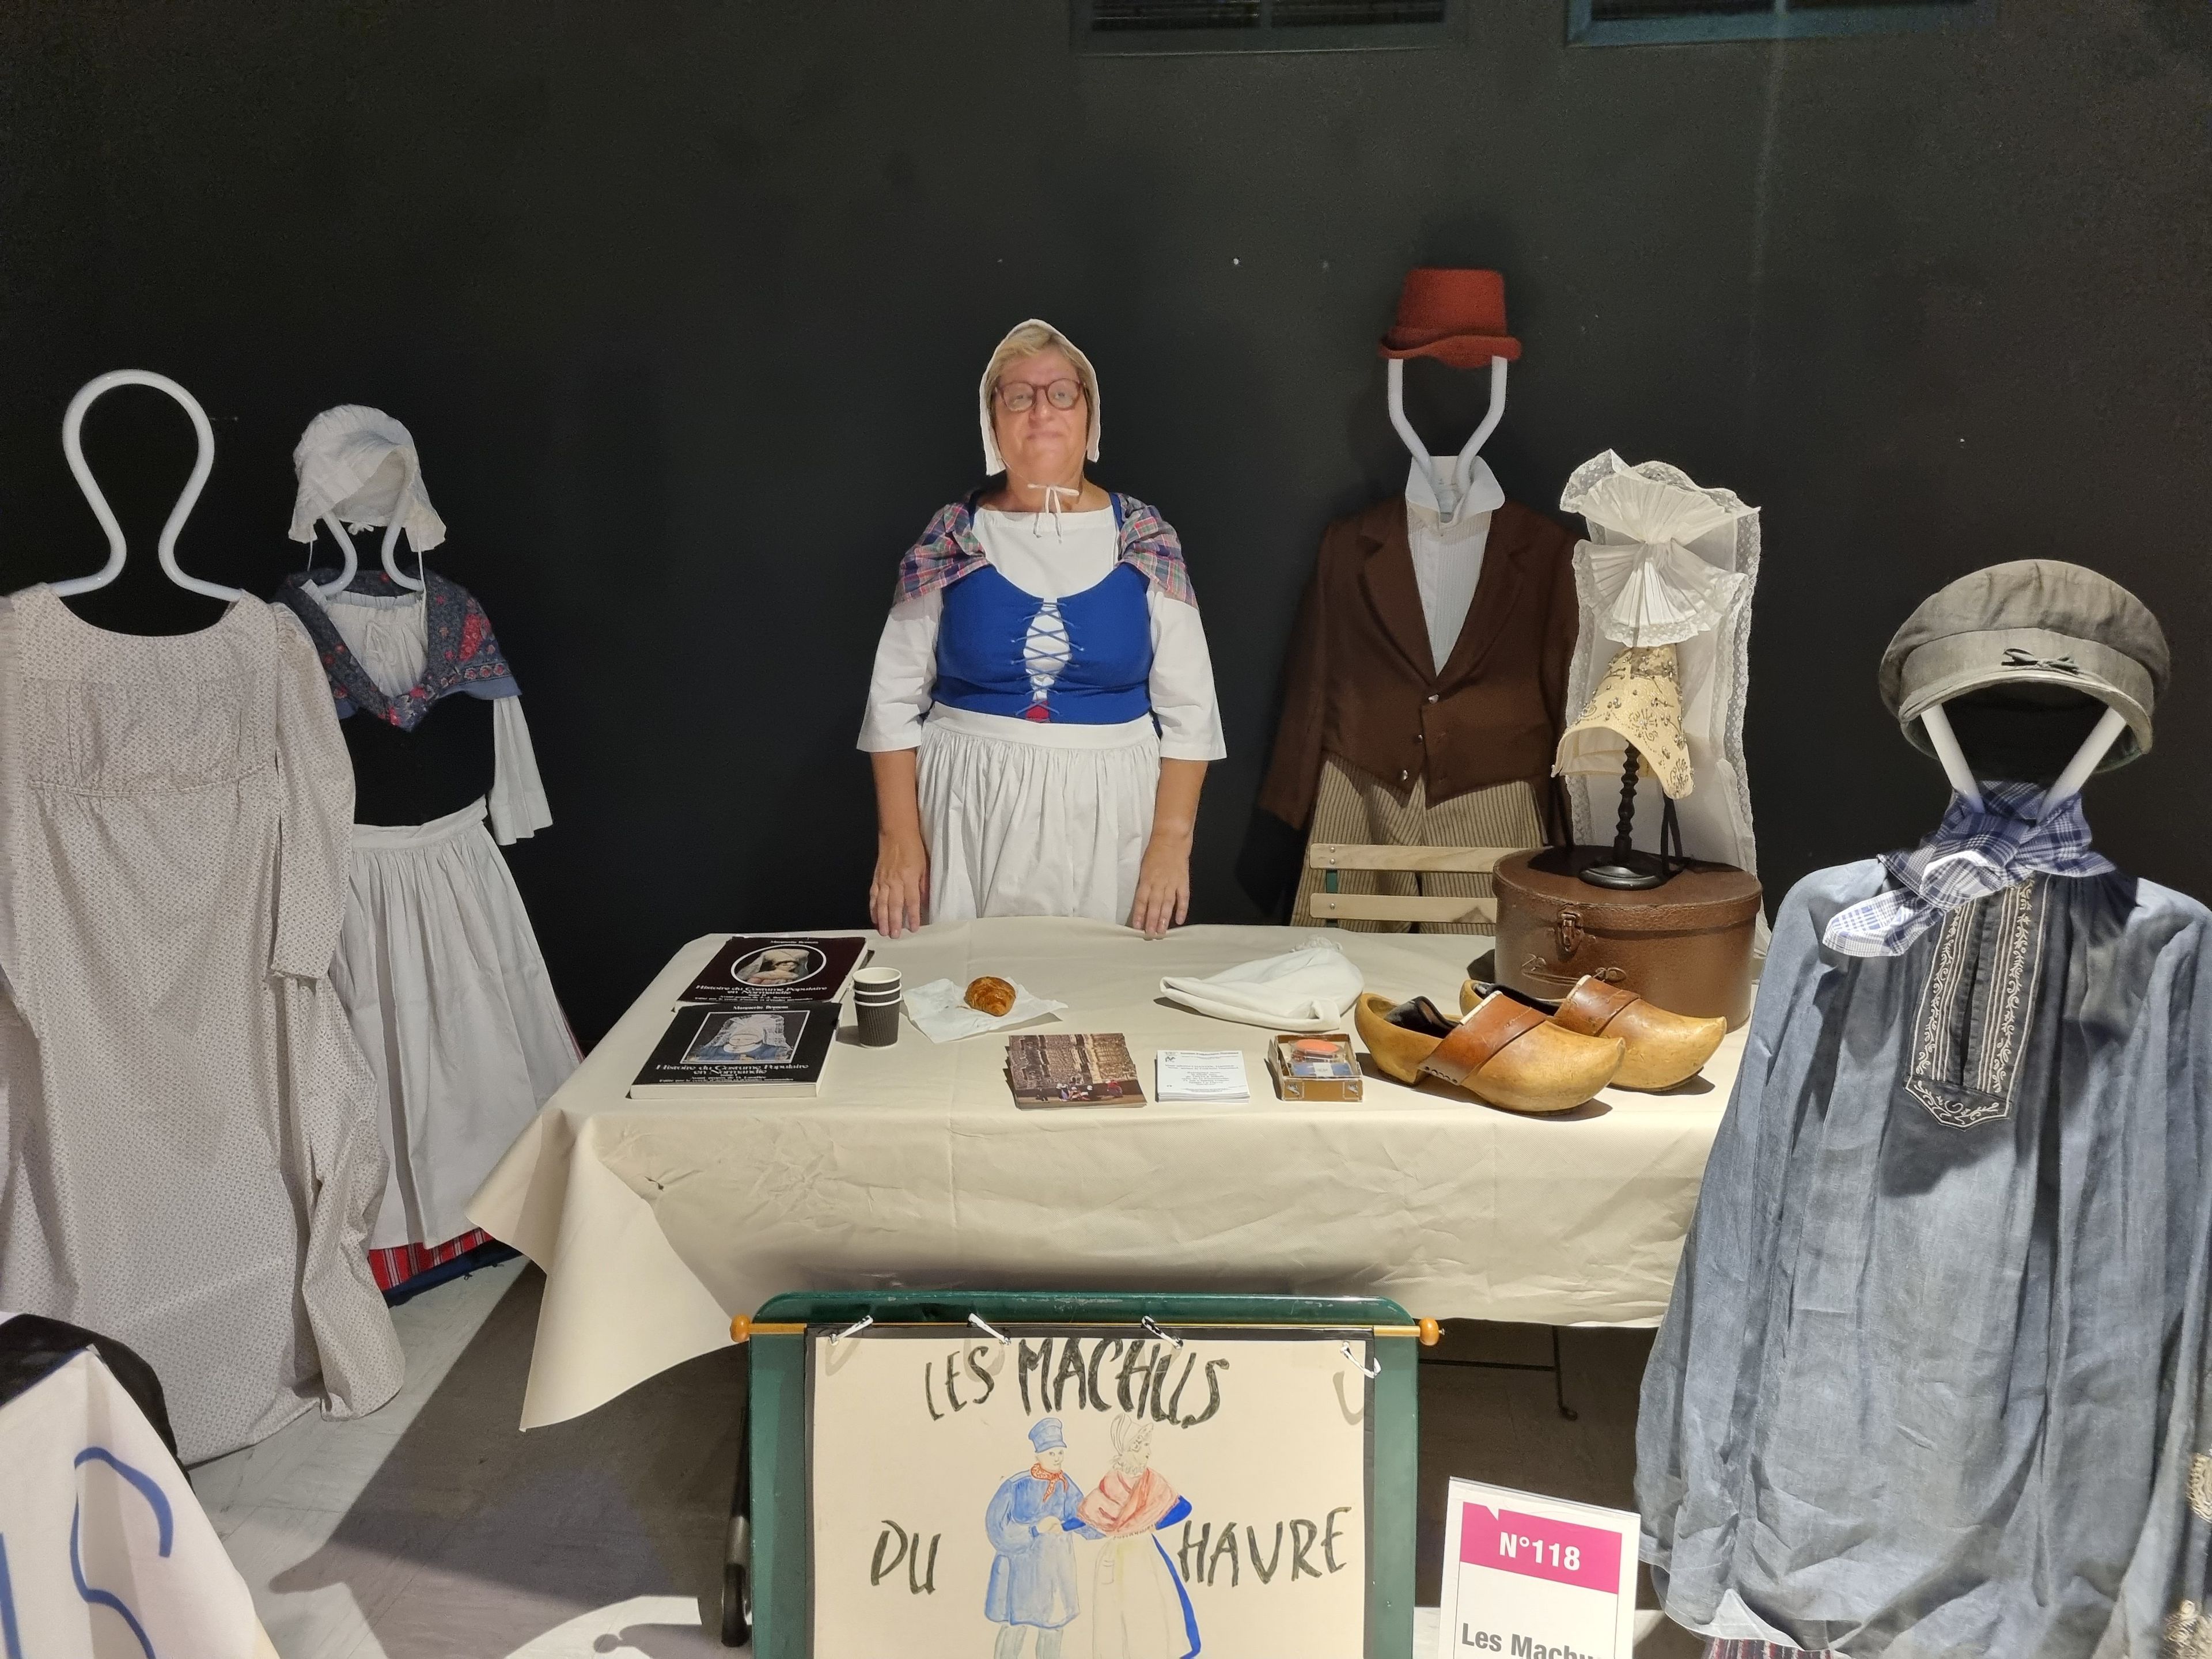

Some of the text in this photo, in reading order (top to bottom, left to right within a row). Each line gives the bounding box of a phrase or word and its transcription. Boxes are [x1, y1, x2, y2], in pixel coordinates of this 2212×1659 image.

[926, 1337, 1230, 1429] LES MACHUS
[870, 1506, 1352, 1595] DU HAVRE
[1498, 1531, 1581, 1571] N°118
[1461, 1622, 1502, 1652] Les
